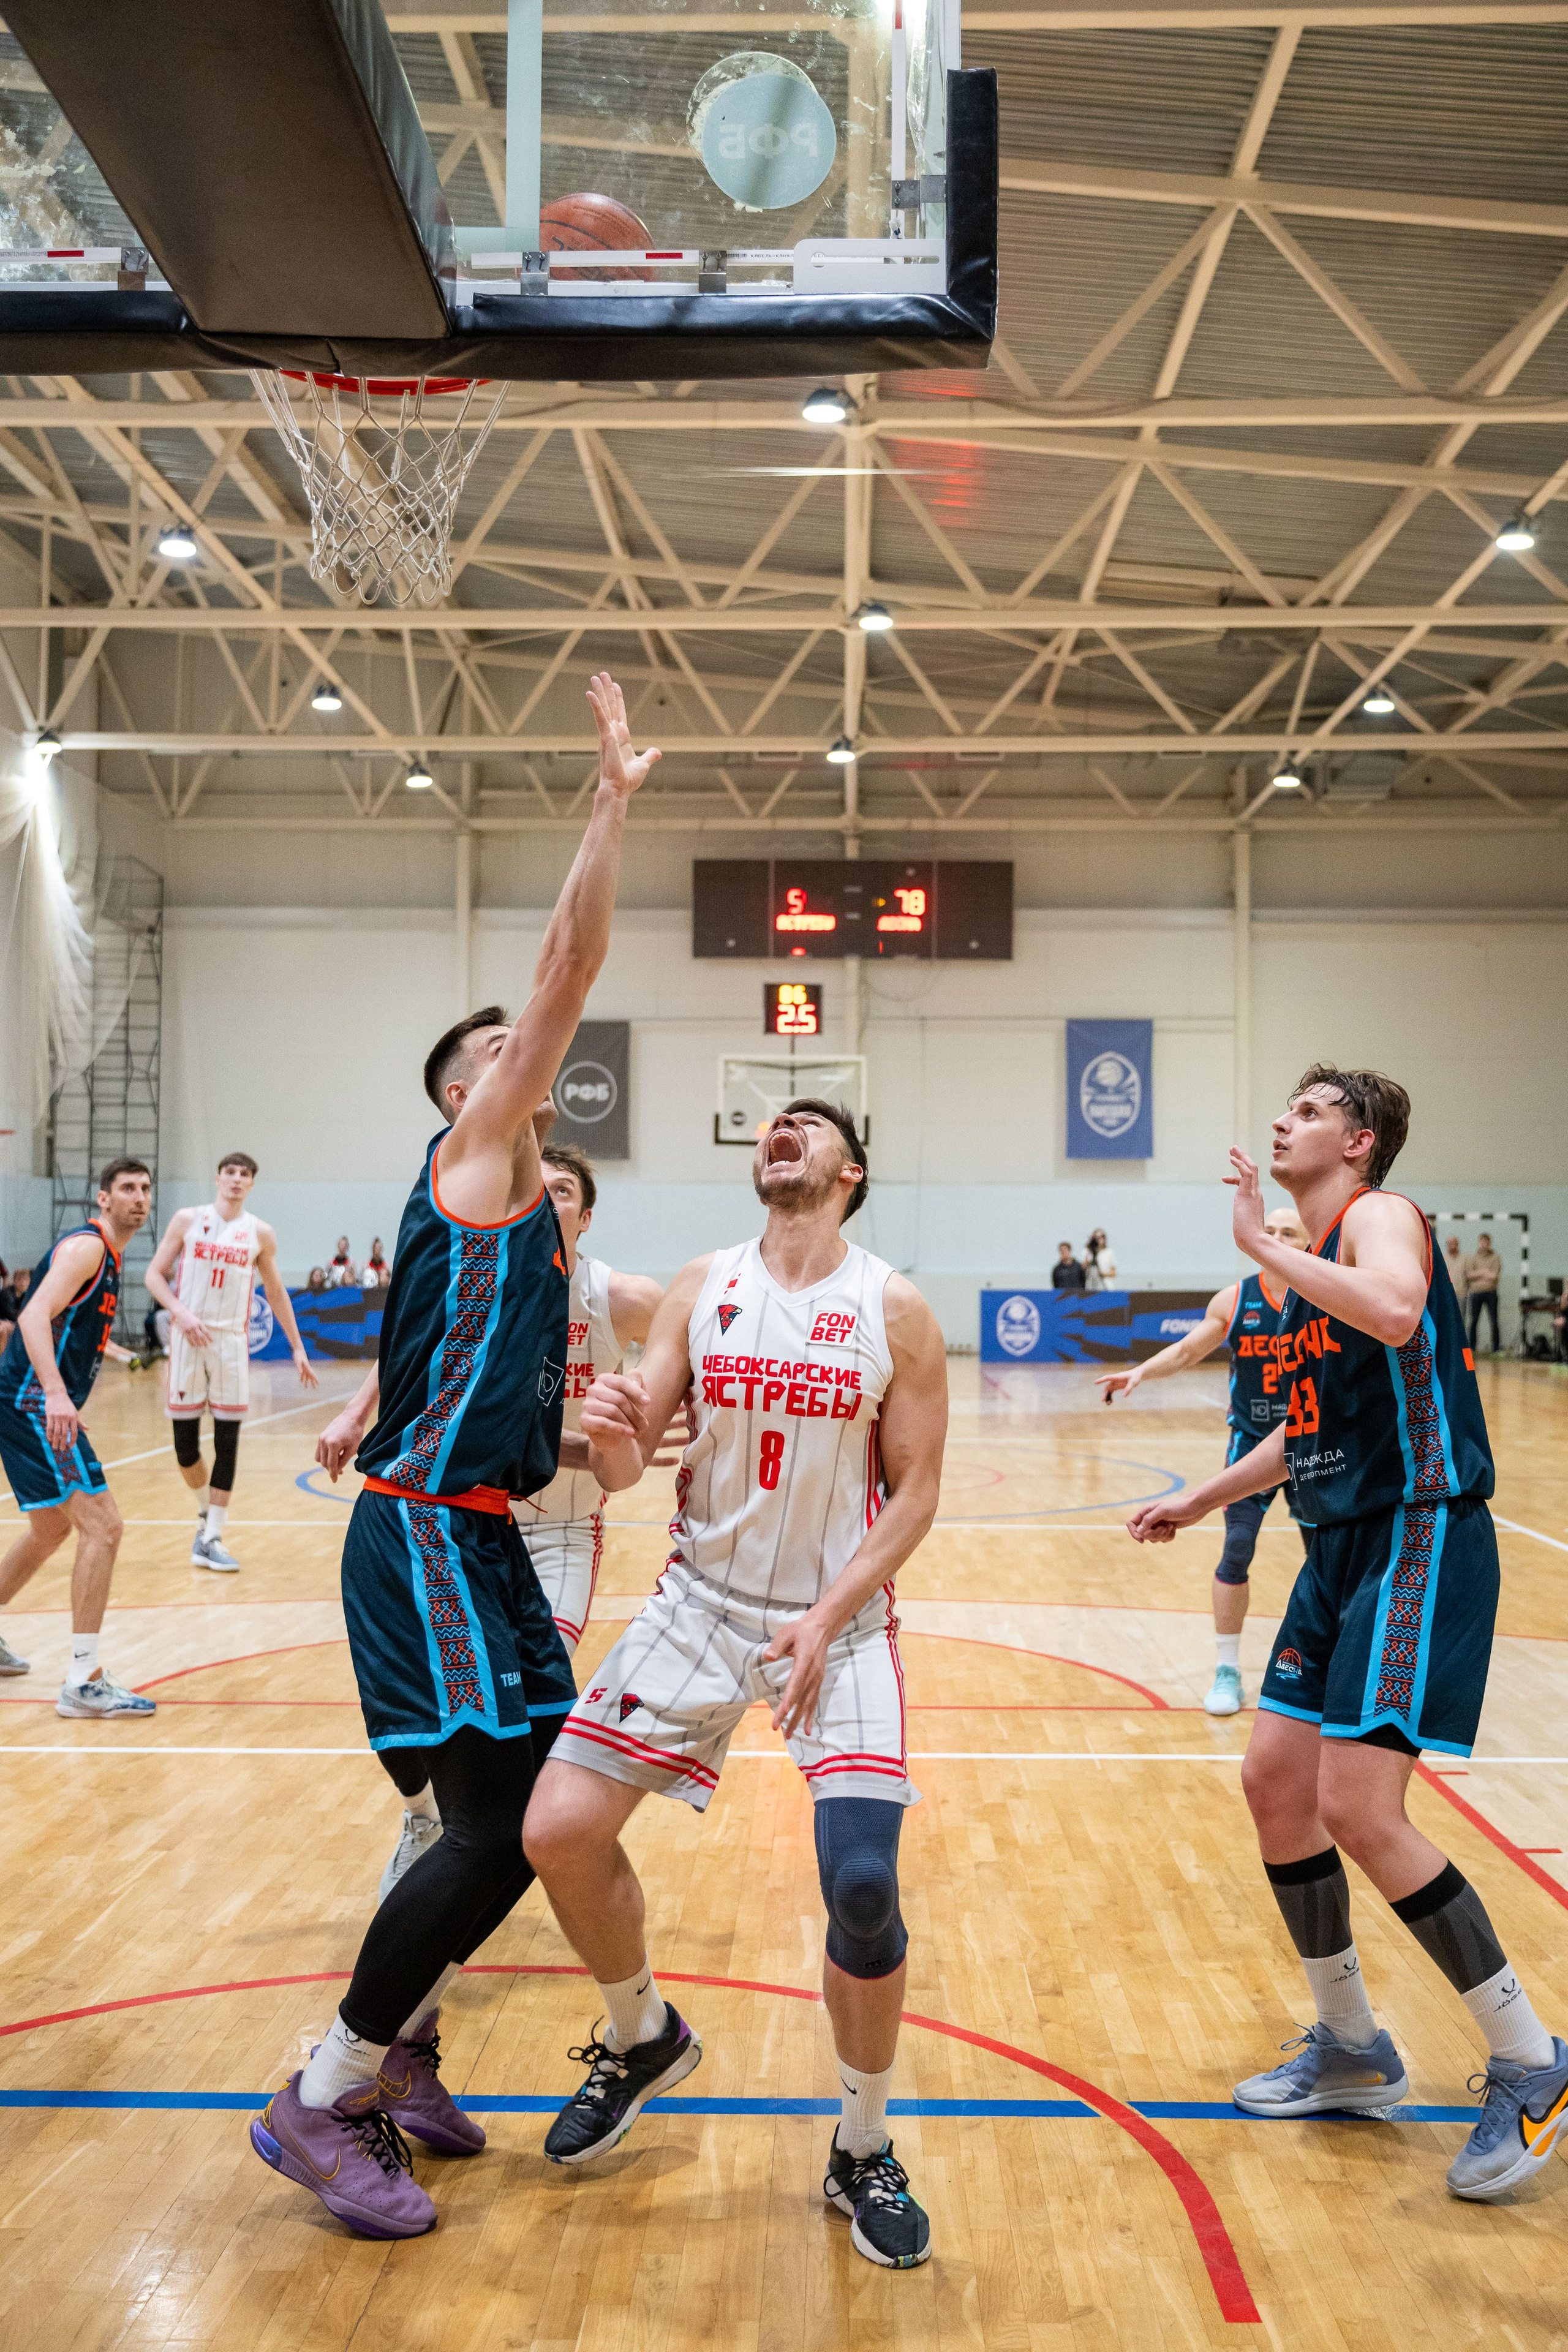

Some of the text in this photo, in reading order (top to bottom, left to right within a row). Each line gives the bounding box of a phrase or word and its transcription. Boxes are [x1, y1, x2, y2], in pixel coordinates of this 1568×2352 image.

[894, 888, 926, 916] 78
[777, 1003, 817, 1033] 25
[211, 1267, 225, 1289] 11
[568, 1322, 588, 1334] ON
[815, 1313, 856, 1329] FON
[567, 1335, 586, 1345] ET
[810, 1327, 851, 1343] BET
[703, 1355, 862, 1391] ЧЕБОКСАРСКИЕ
[701, 1375, 862, 1420] ЯСТРЕБЫ
[759, 1430, 785, 1490] 8
